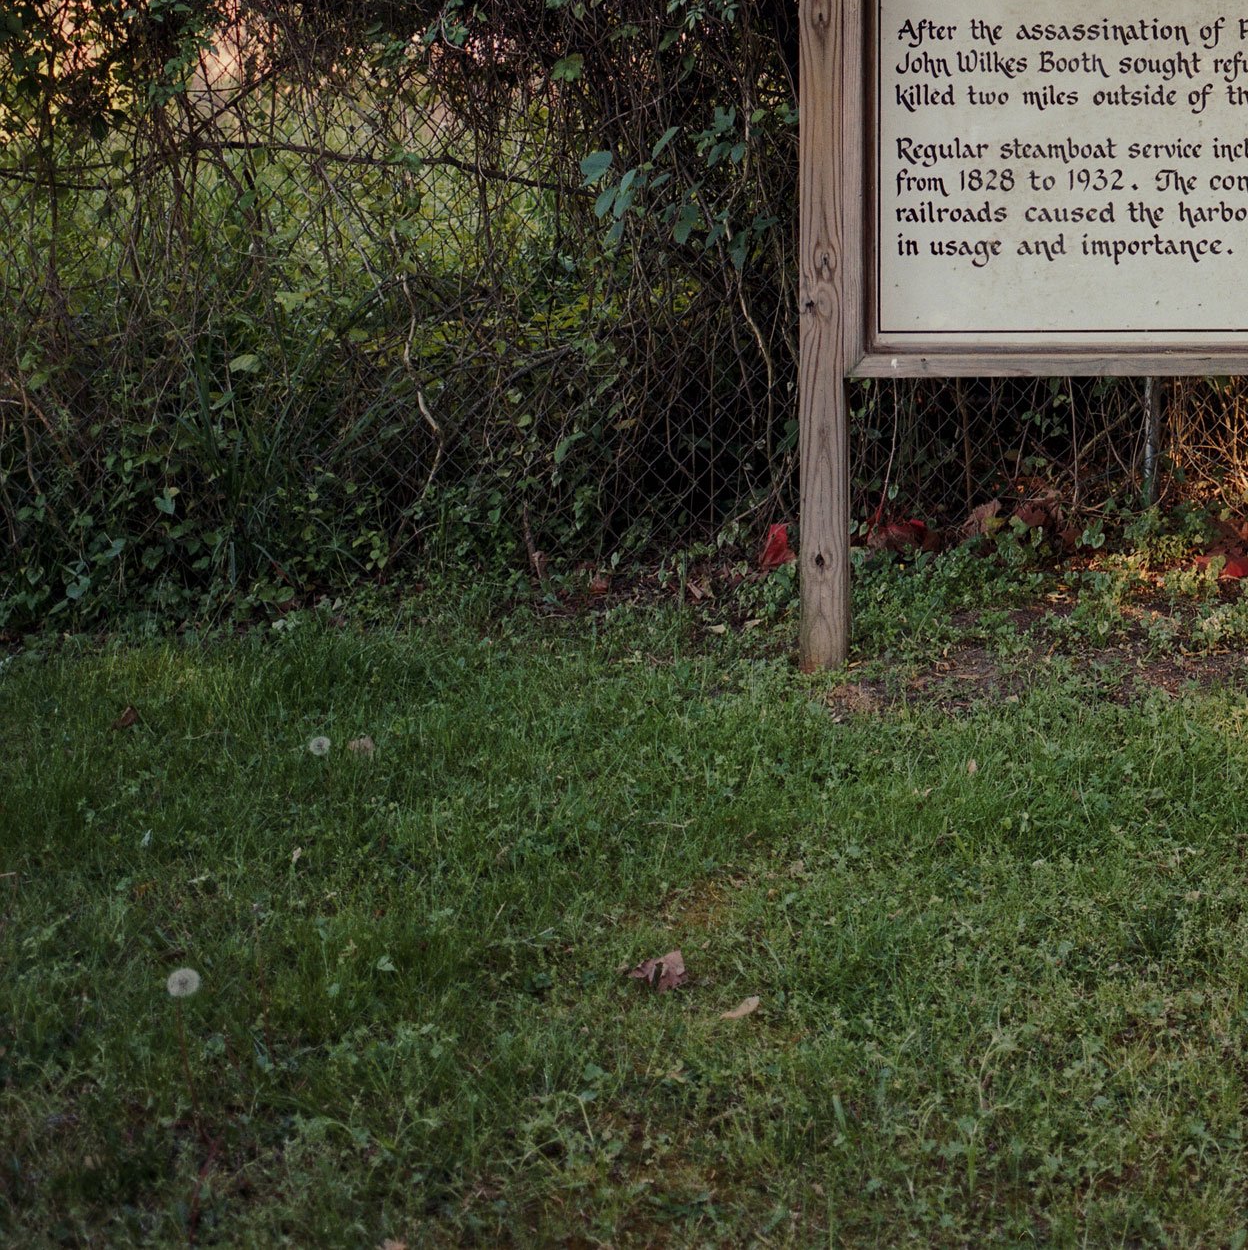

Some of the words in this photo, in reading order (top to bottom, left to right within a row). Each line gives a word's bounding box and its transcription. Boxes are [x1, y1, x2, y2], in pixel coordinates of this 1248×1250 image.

[897, 18, 958, 49] After
[969, 18, 1003, 46] the
[1015, 17, 1190, 47] assassination
[1199, 16, 1226, 50] of
[895, 50, 953, 79] John
[956, 48, 1028, 80] Wilkes
[1037, 50, 1111, 79] Booth
[1118, 50, 1202, 82] sought
[894, 83, 956, 113] killed
[967, 85, 1010, 106] two
[1022, 84, 1079, 112] miles
[1092, 84, 1177, 107] outside
[1187, 82, 1214, 115] of
[895, 136, 990, 168] Regular
[999, 136, 1117, 165] steamboat
[1127, 137, 1203, 159] service
[895, 167, 950, 198] from
[959, 168, 1016, 192] 1828
[1028, 169, 1056, 192] to
[1068, 168, 1139, 192] 1932.
[1154, 168, 1198, 196] The
[895, 200, 1008, 224] railroads
[1024, 201, 1116, 224] caused
[1127, 201, 1165, 230] the
[897, 232, 920, 257] in
[929, 239, 1002, 268] usage
[1016, 232, 1067, 262] and
[1081, 233, 1234, 266] importance.
